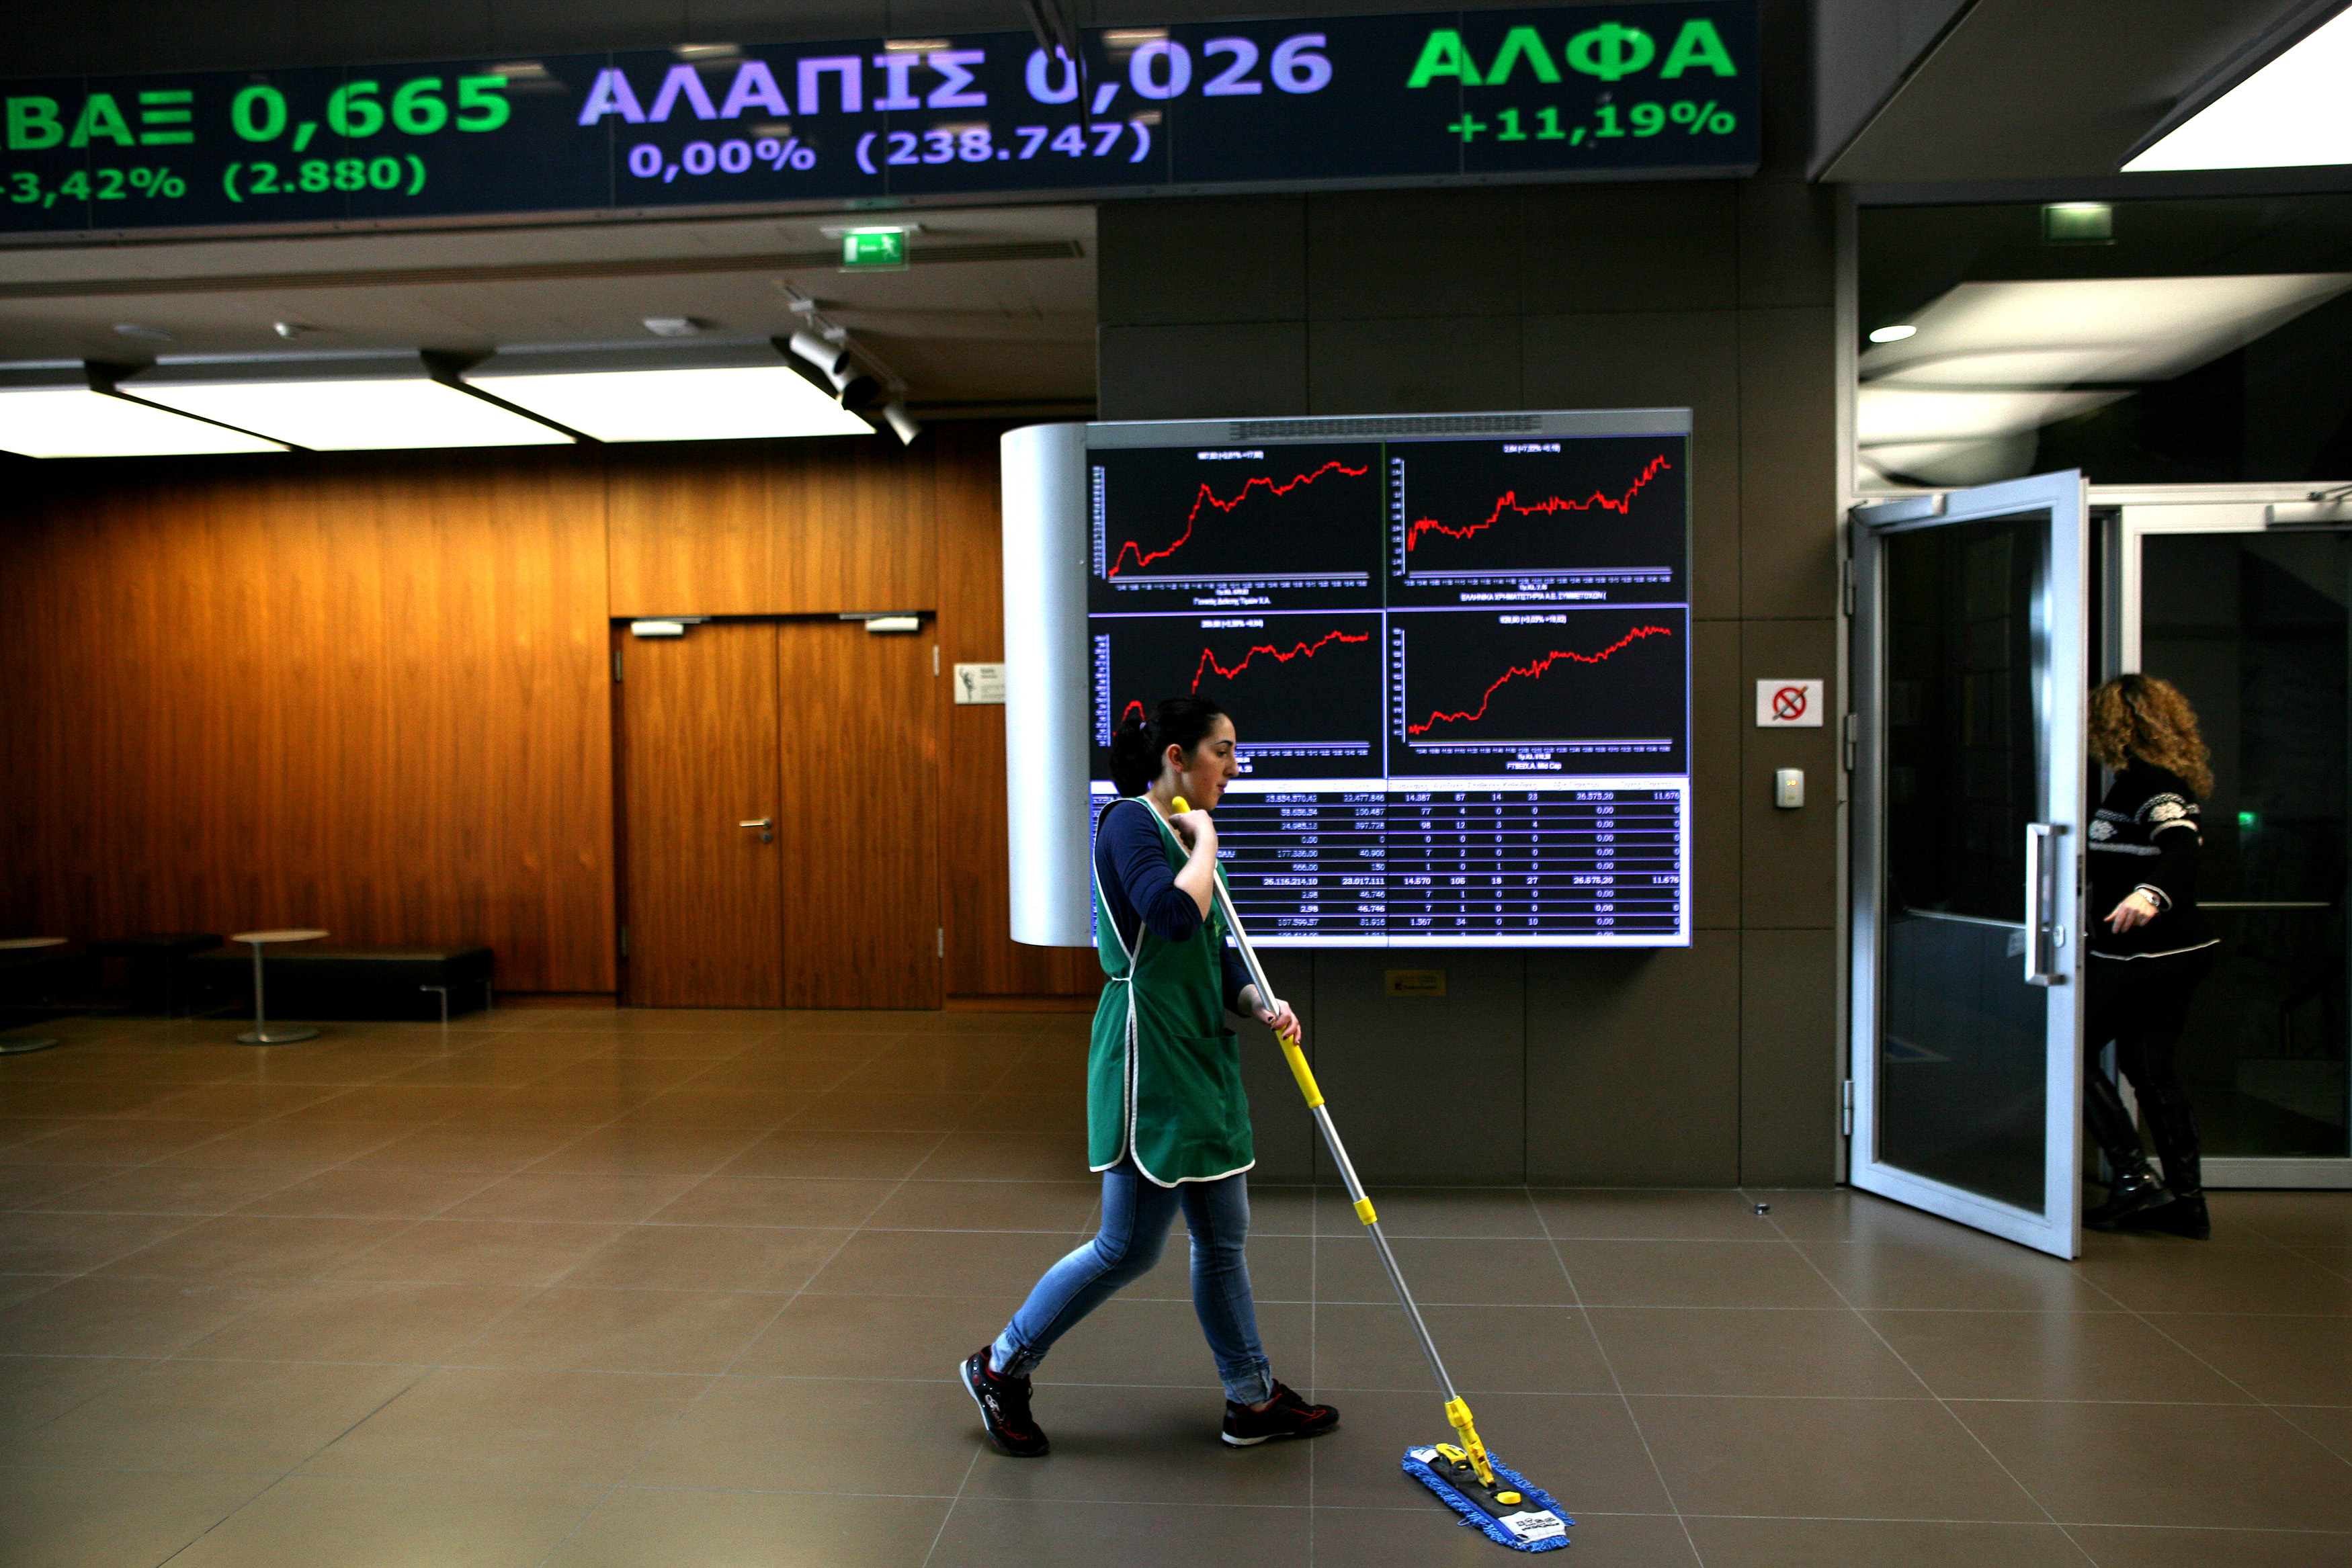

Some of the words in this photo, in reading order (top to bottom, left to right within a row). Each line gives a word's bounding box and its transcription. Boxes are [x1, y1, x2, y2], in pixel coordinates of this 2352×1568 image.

[1405, 18, 1738, 89] ΑΛΦΑ
[577, 48, 988, 126] ΑΛΑΠΙΣ
[1024, 32, 1333, 116] 0,026
[0, 91, 195, 150] ΒΑΞ
[230, 75, 511, 153] 0,665
[1447, 101, 1736, 146] +11,19%
[628, 136, 816, 183] 0,00%
[855, 121, 1152, 175] (238.747)
[223, 154, 426, 204] (2.880)
[1421, 806, 1431, 815] 77
[1455, 793, 1466, 801] 87
[1528, 793, 1538, 801] 23
[1420, 821, 1431, 829] 98
[1456, 821, 1466, 829] 12
[1491, 876, 1503, 884] 18
[1526, 876, 1538, 884] 27
[1595, 904, 1614, 912] 0,00
